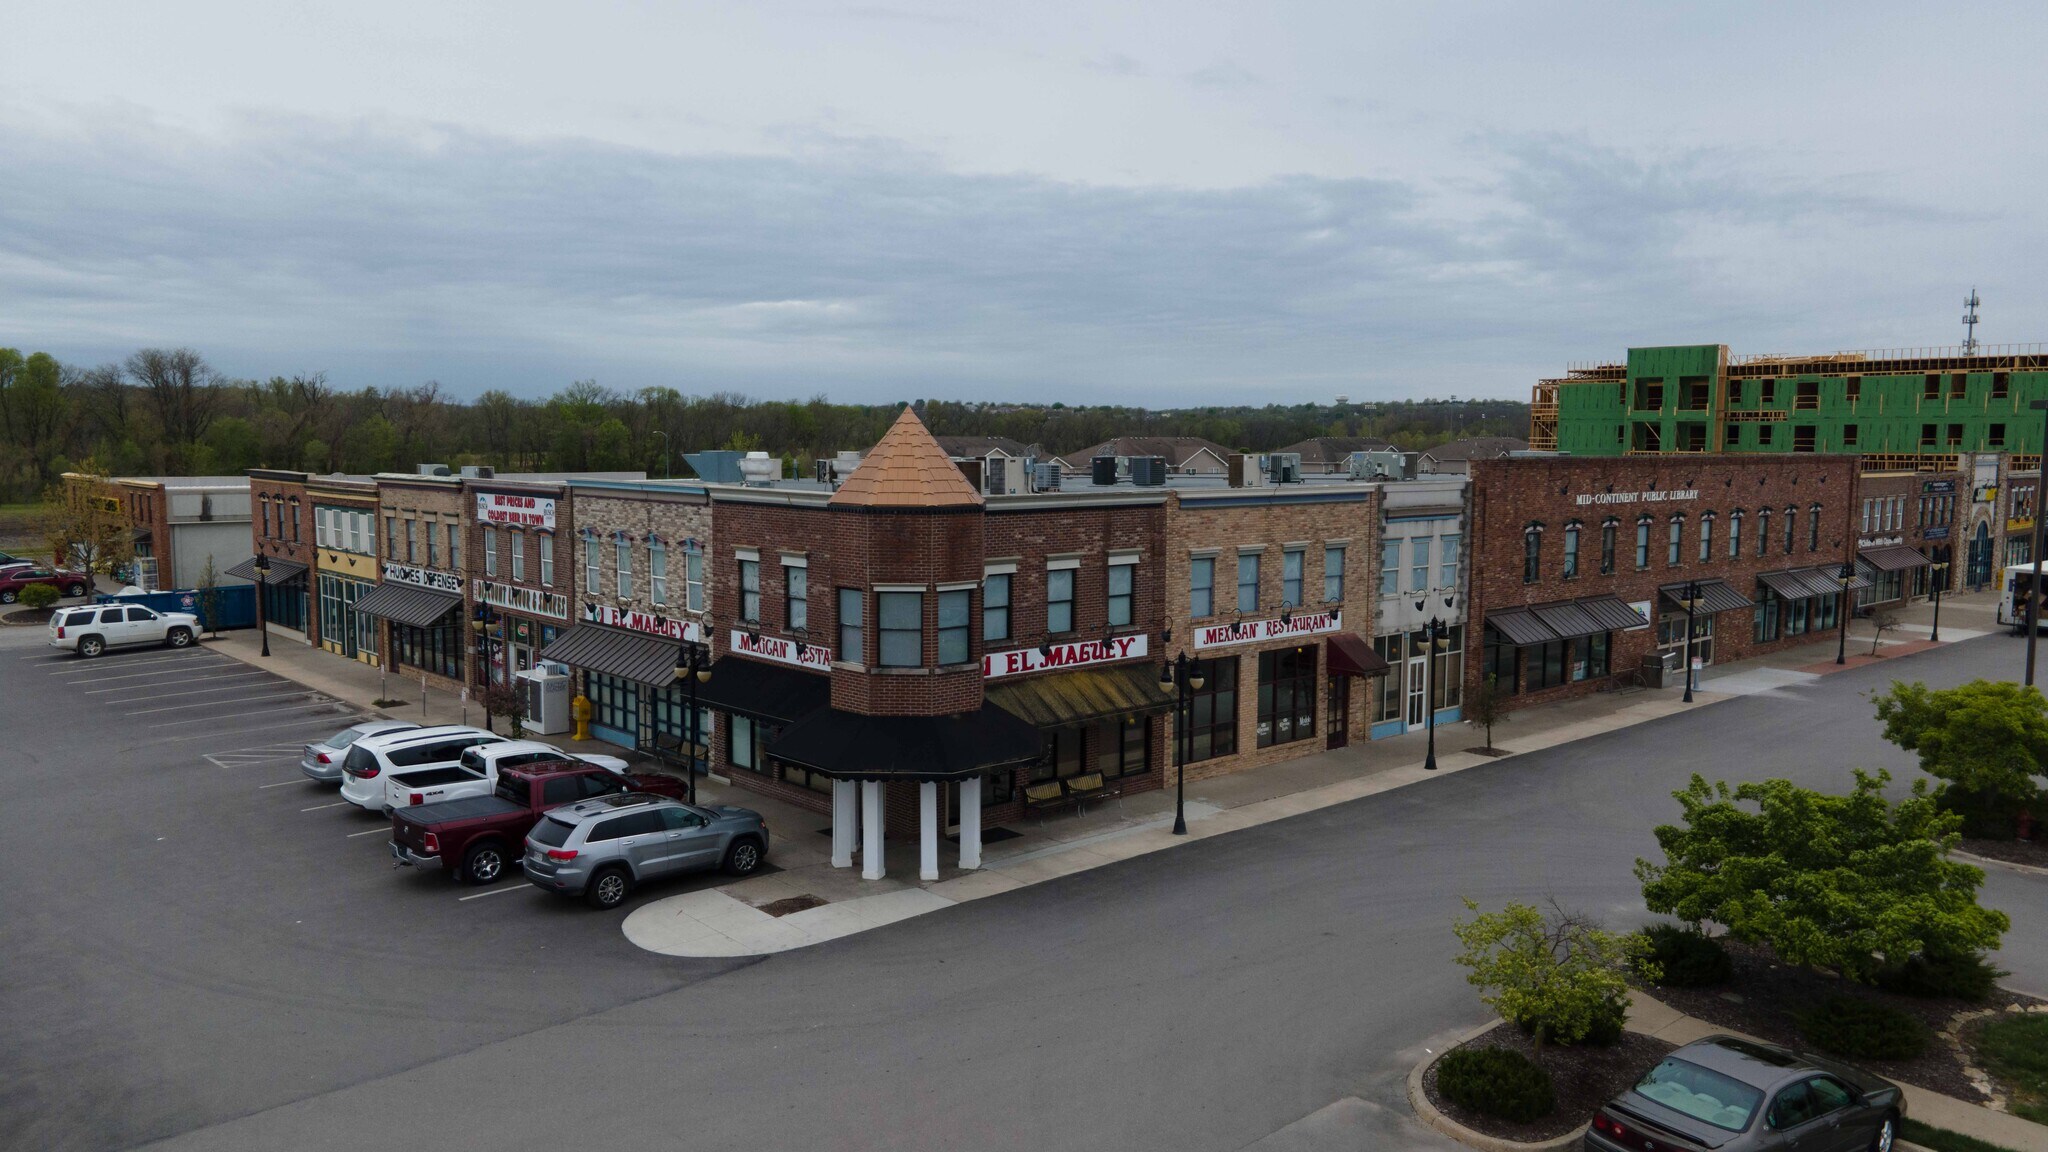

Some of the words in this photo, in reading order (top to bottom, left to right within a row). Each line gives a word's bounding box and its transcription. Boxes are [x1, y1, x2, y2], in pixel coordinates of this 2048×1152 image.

[1576, 492, 1639, 505] MID-CONTINENT
[1641, 491, 1668, 502] PUBLIC
[1669, 489, 1699, 500] LIBRARY
[1005, 651, 1035, 674] EL
